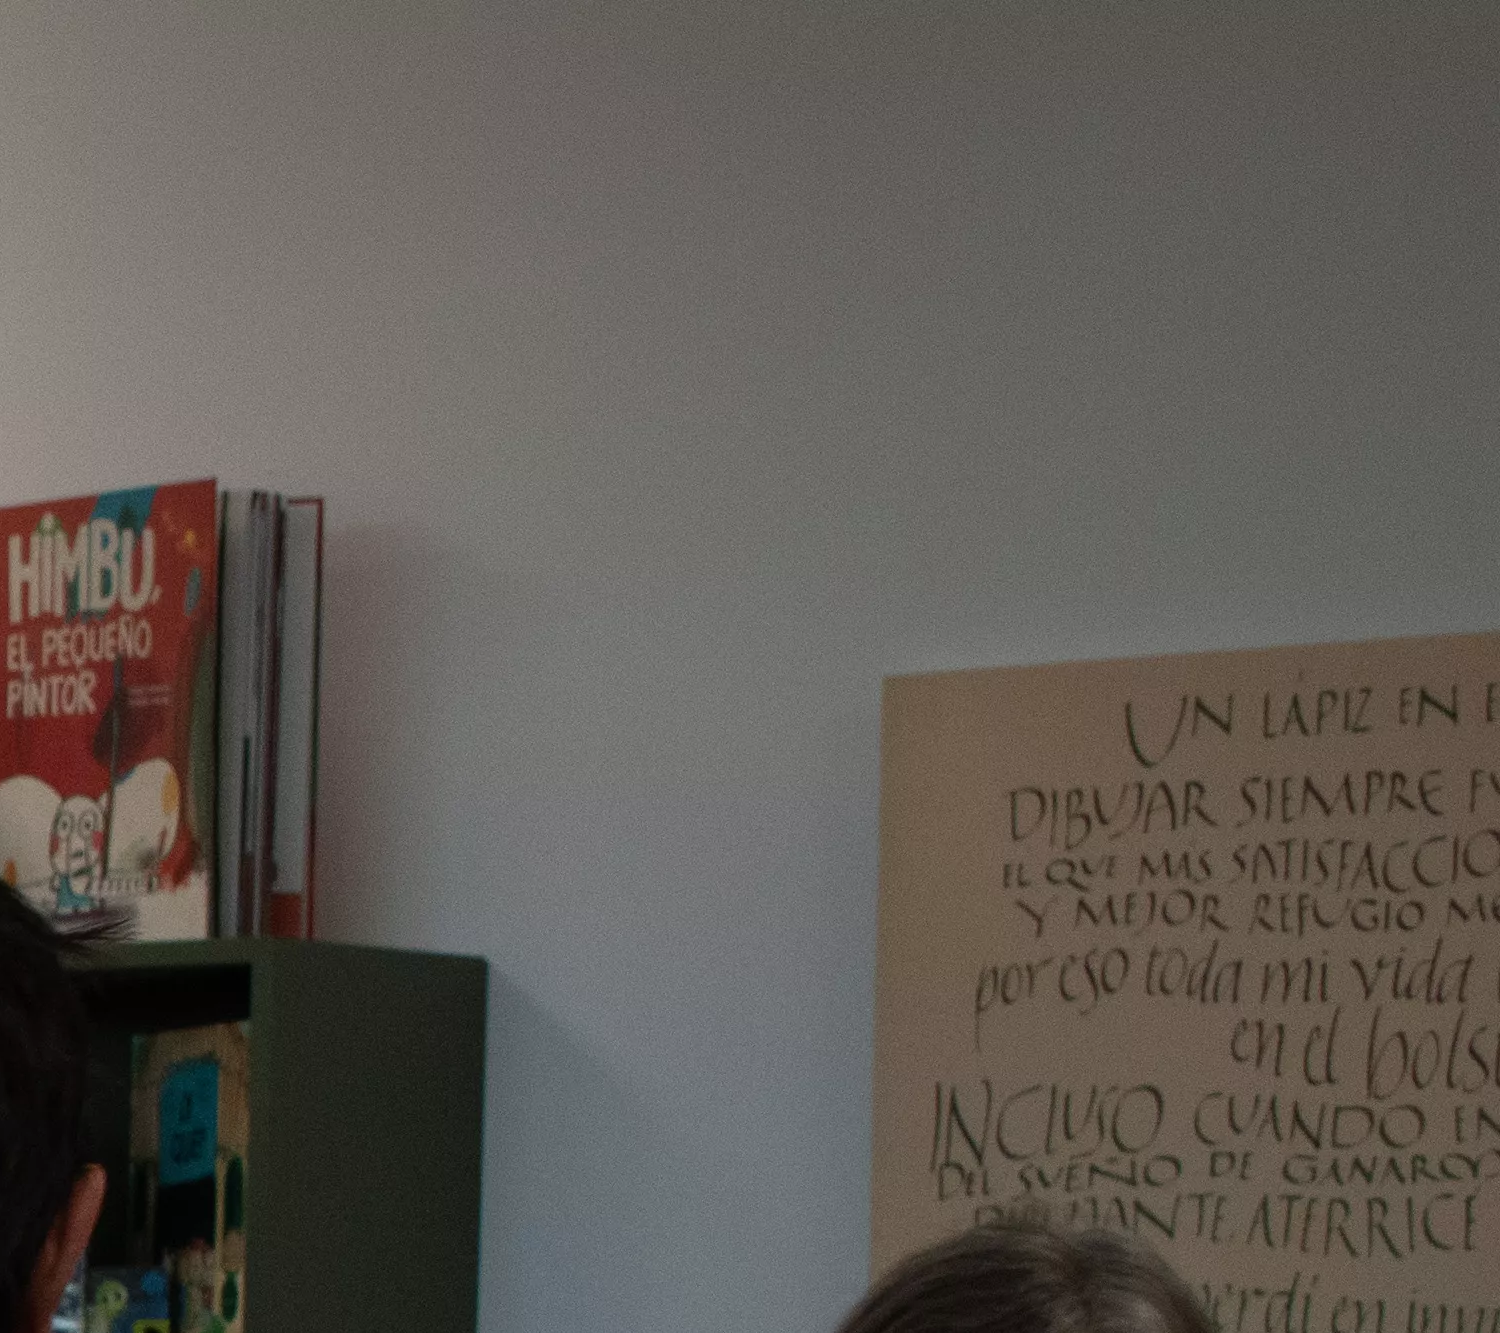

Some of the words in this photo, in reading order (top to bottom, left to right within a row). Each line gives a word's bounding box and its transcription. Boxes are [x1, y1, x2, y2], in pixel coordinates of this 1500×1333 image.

[6, 630, 32, 673] EL
[42, 614, 154, 671] PEQUEÑO
[6, 666, 97, 720] PINTOR
[1124, 692, 1235, 769] UN
[1399, 684, 1459, 728] EN
[1007, 779, 1218, 850] DIBUJAR
[1235, 768, 1445, 829] SIEMPRE
[1003, 862, 1030, 890] EL
[1014, 895, 1060, 938] Y
[1073, 887, 1231, 938] MEJOR
[1247, 892, 1426, 938] REFUGIO
[973, 957, 1054, 1053] por
[1058, 945, 1131, 1017] eso
[1145, 939, 1243, 1003] toda
[1261, 949, 1328, 1003] mi
[1351, 937, 1474, 1003] vida
[1230, 1017, 1286, 1077] en
[1304, 1005, 1342, 1086] el
[929, 1078, 1165, 1172] INCLUSO
[1193, 1091, 1427, 1151] CUANDO
[937, 1161, 990, 1202] DEL
[1209, 1150, 1253, 1181] DE
